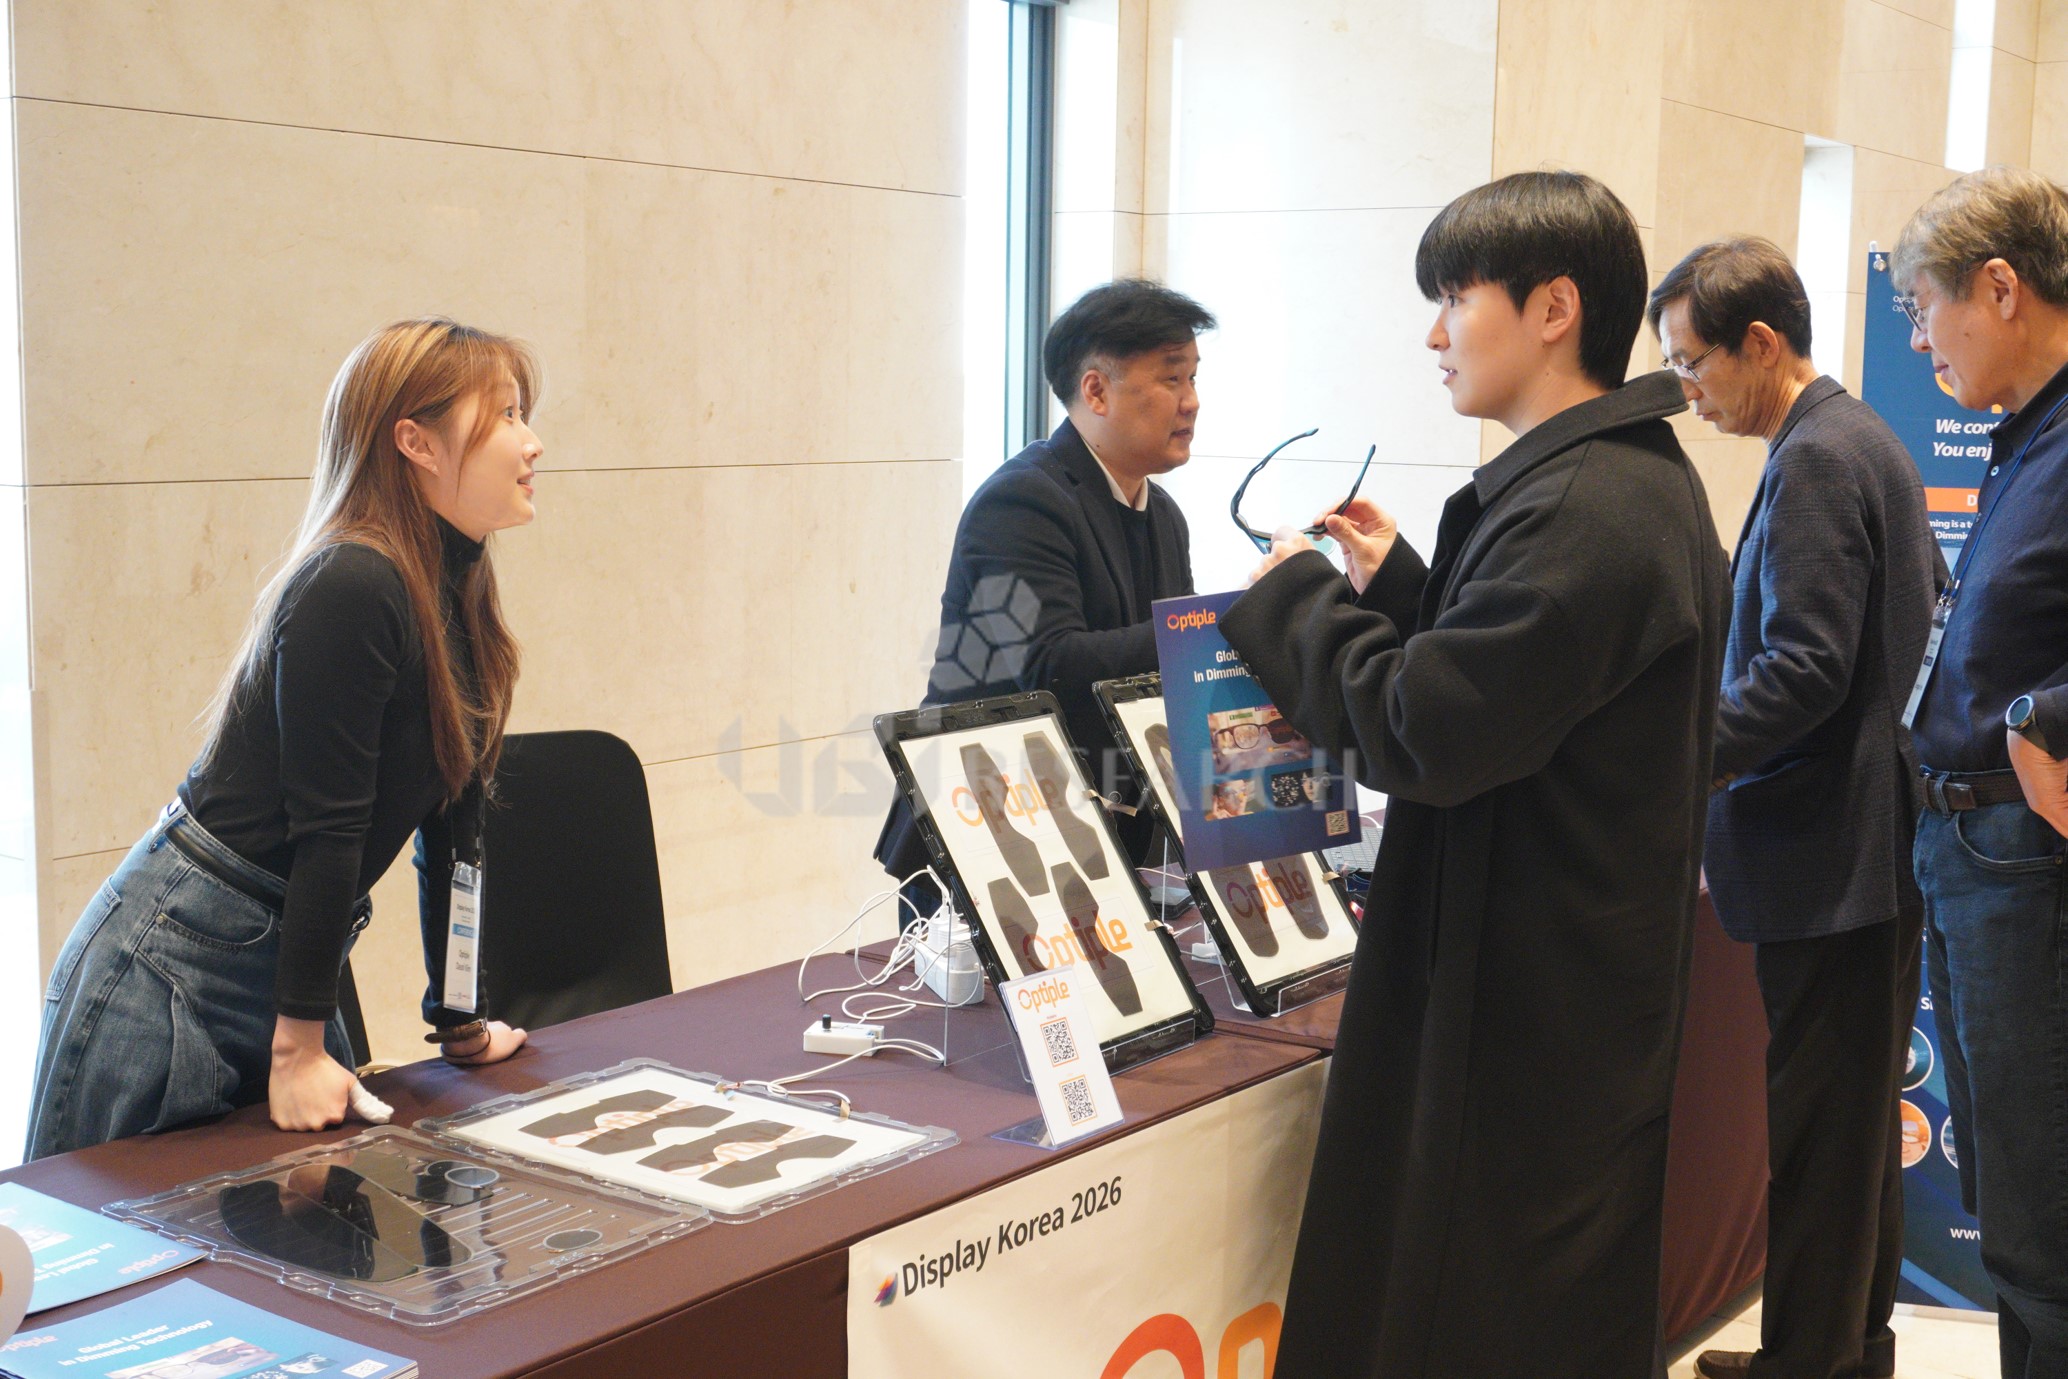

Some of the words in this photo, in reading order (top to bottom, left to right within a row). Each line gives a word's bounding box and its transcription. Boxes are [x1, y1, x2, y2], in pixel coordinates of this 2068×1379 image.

[1936, 419, 1962, 434] We
[1933, 441, 1965, 457] You
[1951, 519, 1959, 528] is
[1167, 608, 1216, 632] Optiple
[952, 768, 1064, 834] Optiple
[1226, 862, 1314, 925] Optiple
[1017, 978, 1071, 1013] Optiple
[902, 1237, 991, 1297] Display
[997, 1207, 1064, 1255] Korea
[1070, 1176, 1122, 1224] 2026
[0, 1335, 59, 1352] ptiple
[75, 1343, 141, 1364] Dimming
[138, 1319, 214, 1347] Technology
[78, 1338, 124, 1354] Global
[121, 1324, 170, 1343] Leader
